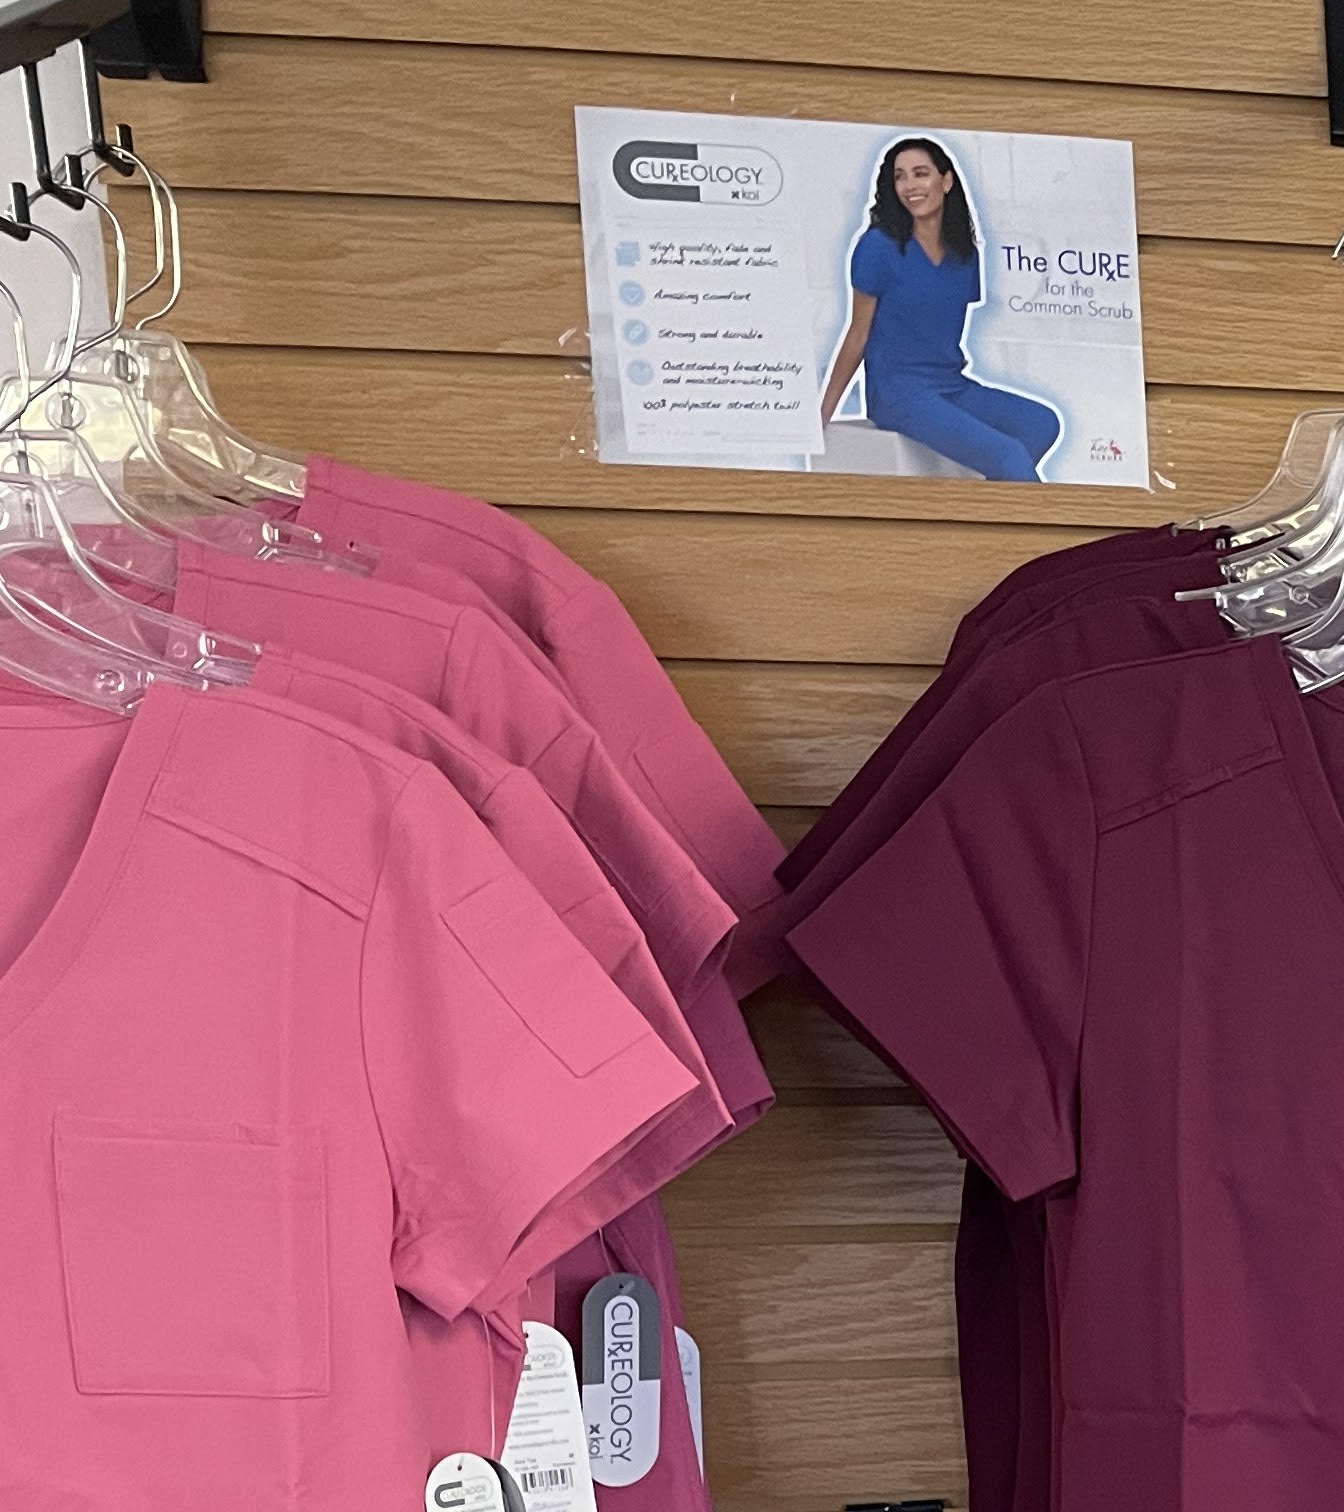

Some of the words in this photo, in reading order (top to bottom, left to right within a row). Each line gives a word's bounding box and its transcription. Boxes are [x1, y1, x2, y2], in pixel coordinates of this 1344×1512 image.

[742, 187, 760, 200] koi
[753, 244, 772, 253] and
[1001, 245, 1048, 273] The
[1044, 276, 1066, 296] for
[1071, 279, 1094, 298] the
[654, 288, 699, 305] Amazing
[703, 291, 751, 302] comfort
[1008, 295, 1082, 316] Common
[1088, 300, 1134, 319] Scrub
[658, 328, 696, 343] Strong
[700, 330, 719, 340] and
[722, 328, 763, 340] durable
[661, 360, 729, 376] Outstanding
[733, 360, 803, 376] breathability
[662, 376, 682, 385] and
[669, 398, 721, 413] polyester
[727, 399, 770, 410] stretch
[774, 399, 801, 411] twill
